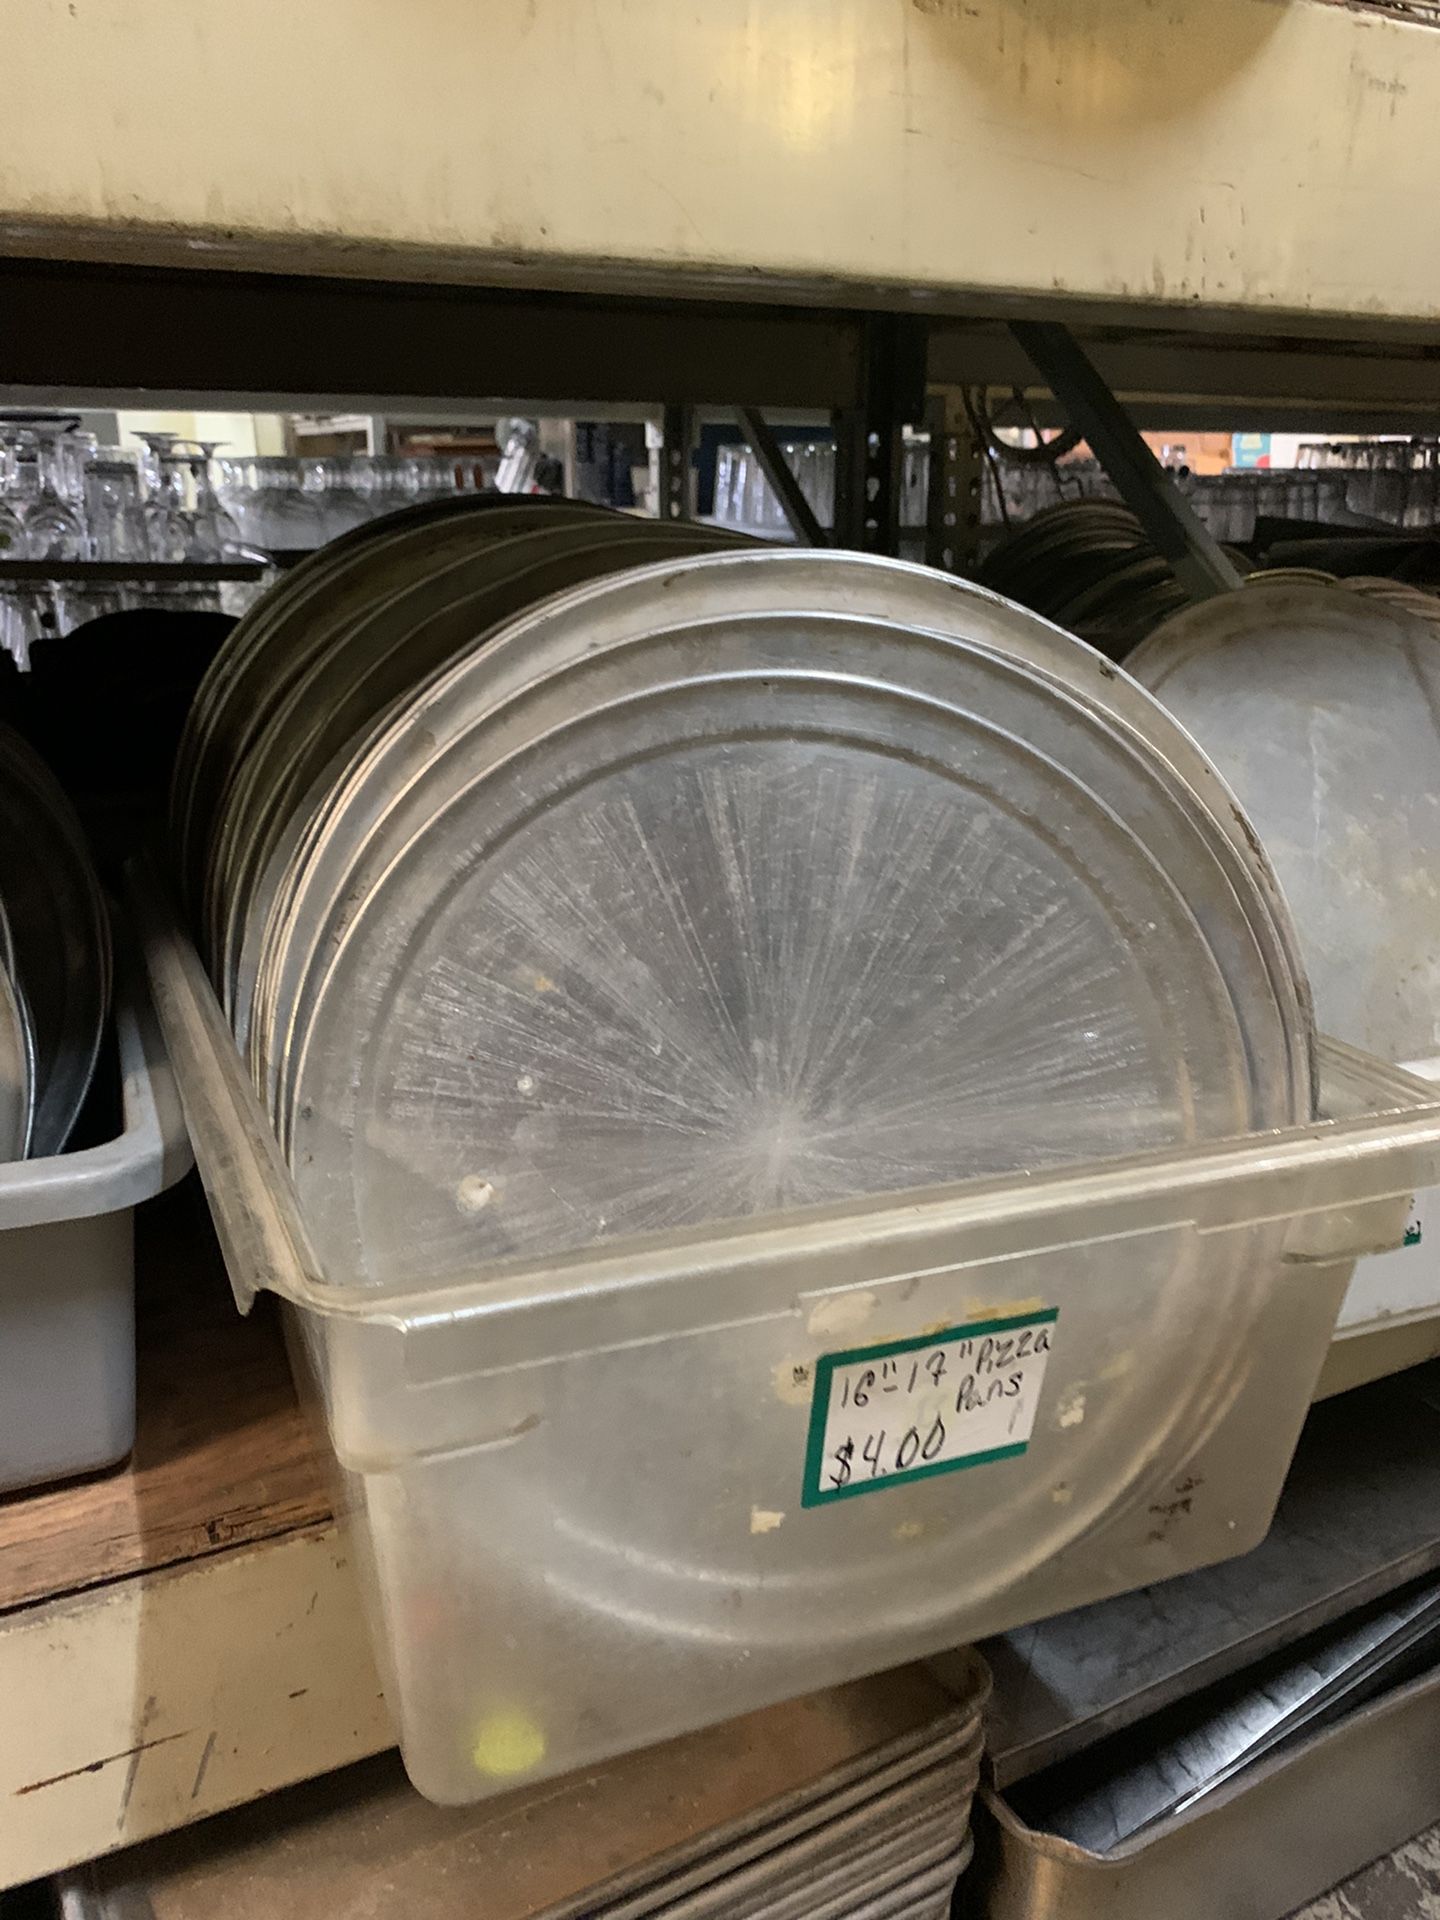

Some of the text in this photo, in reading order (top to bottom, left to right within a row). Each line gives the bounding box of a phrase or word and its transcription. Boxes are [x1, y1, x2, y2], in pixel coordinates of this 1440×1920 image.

[976, 1328, 1051, 1374] Pizza
[956, 1371, 1024, 1413] Pans
[829, 1411, 946, 1490] $4.00
